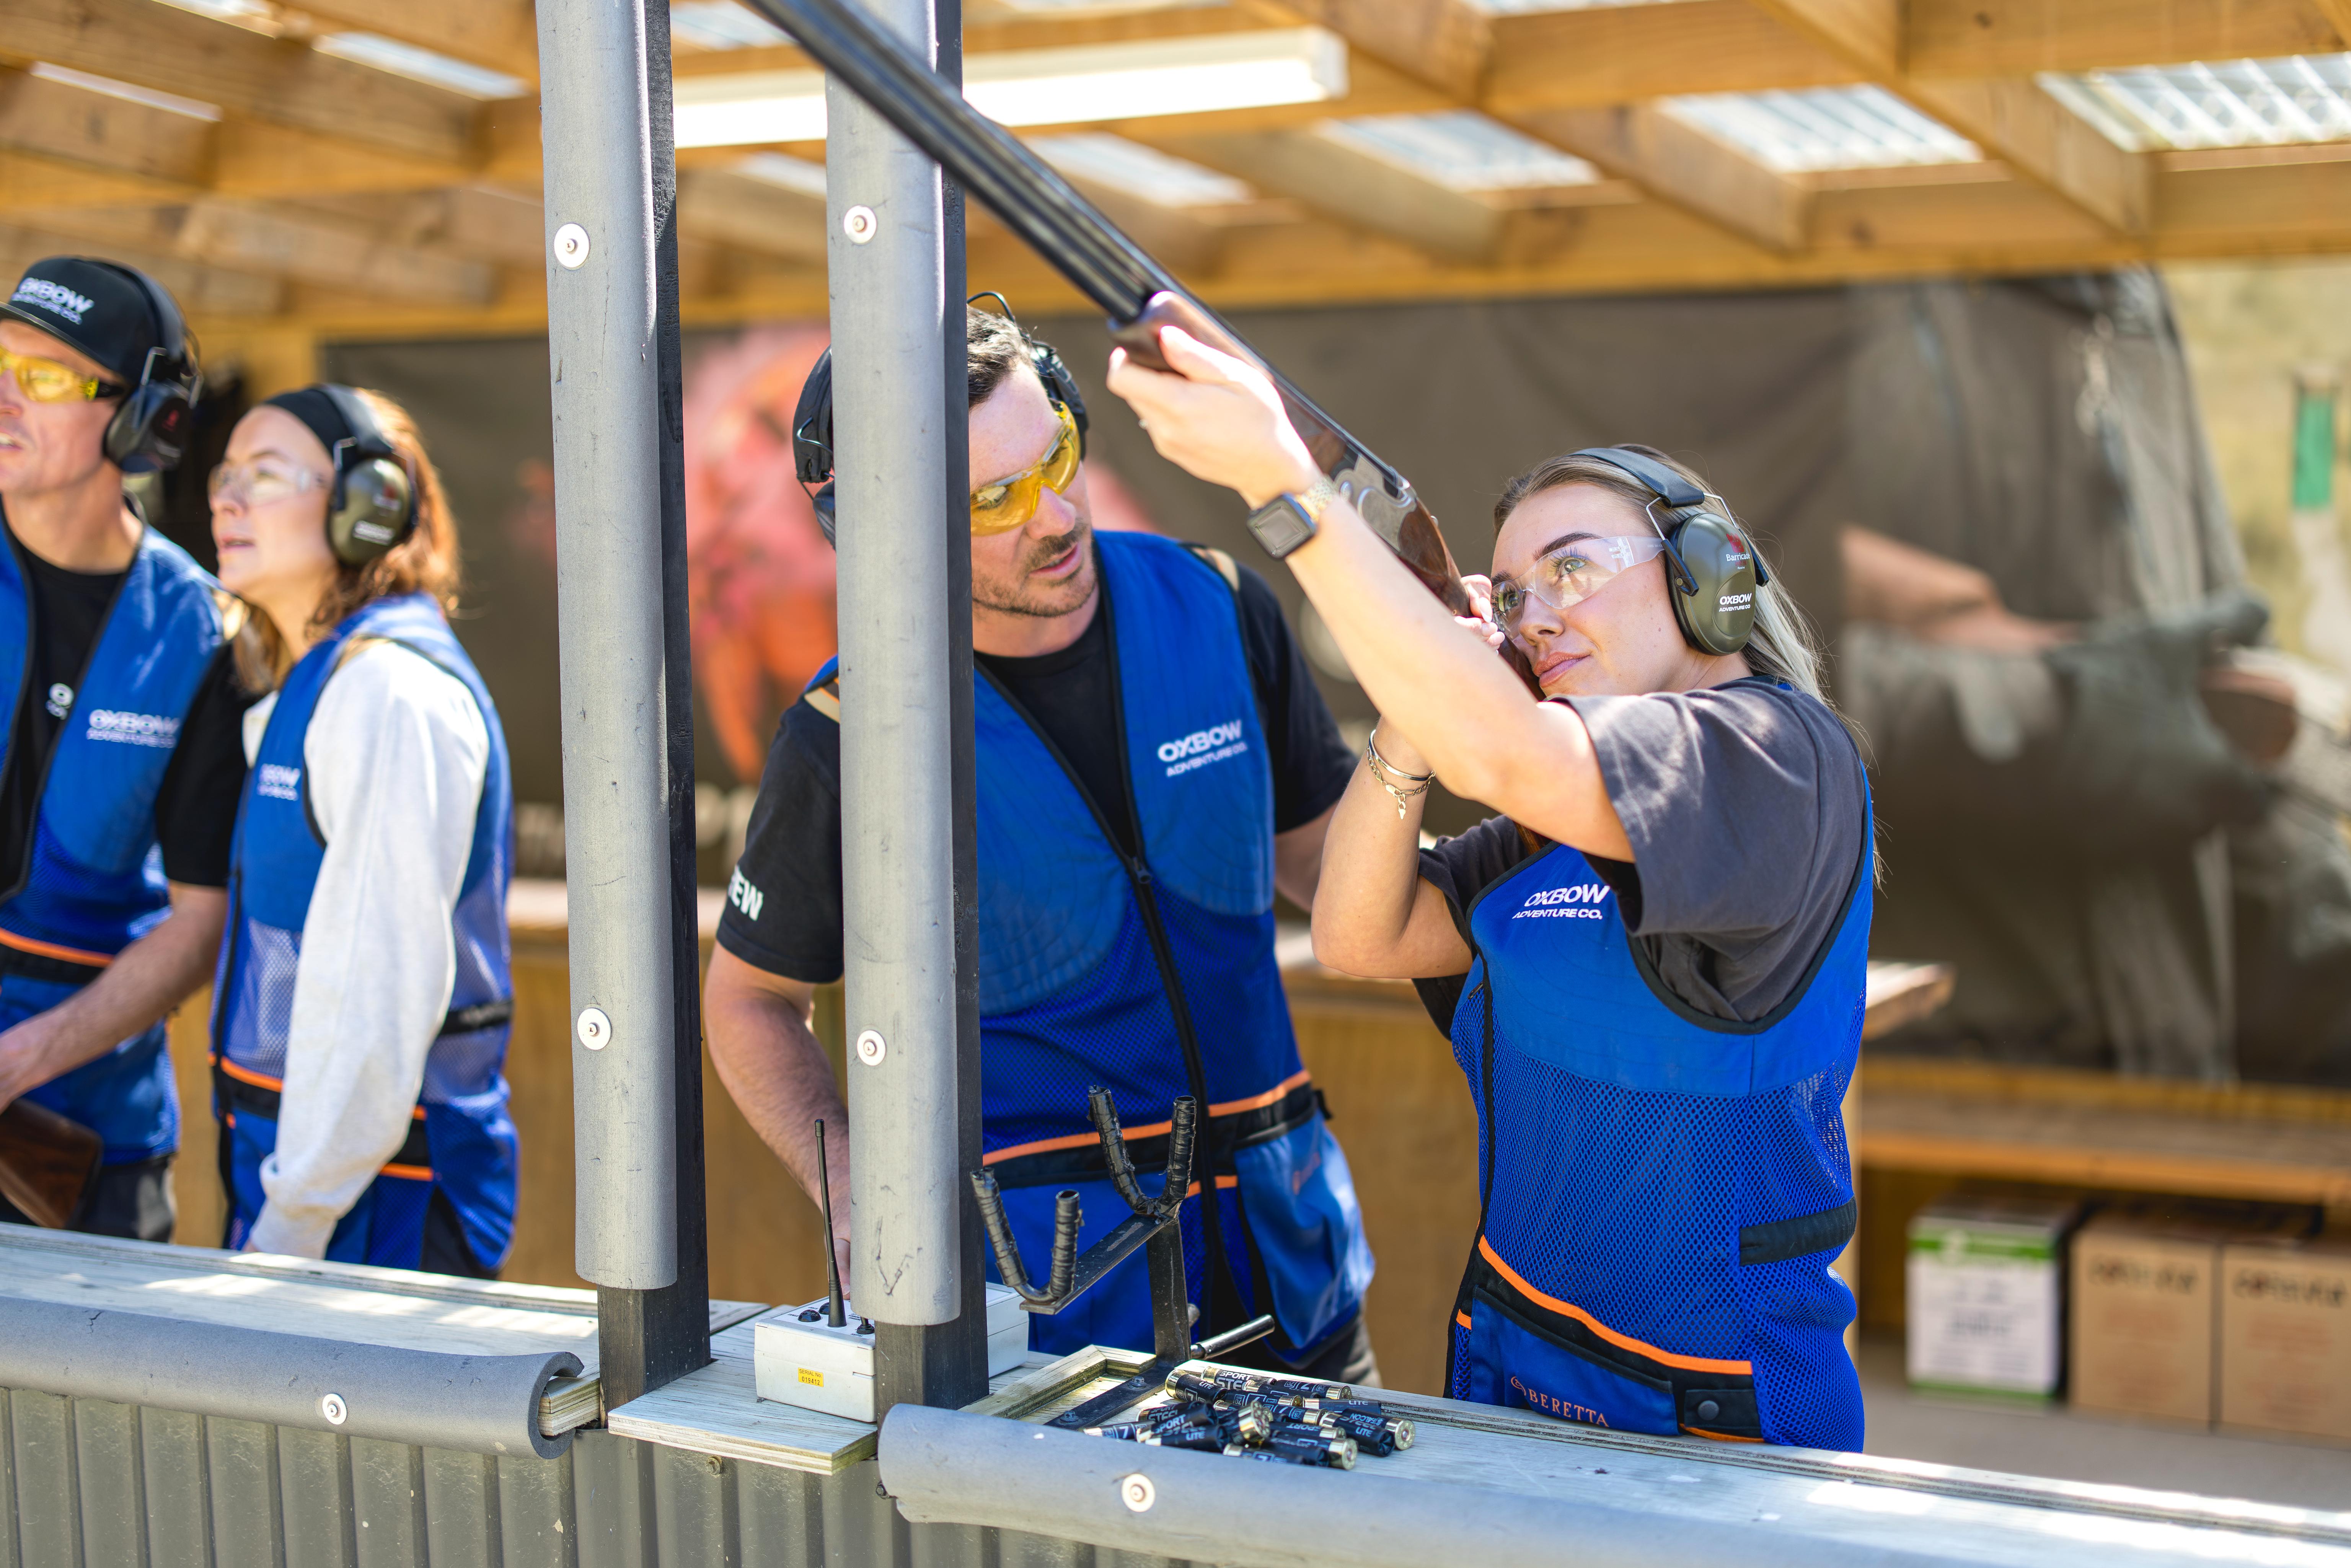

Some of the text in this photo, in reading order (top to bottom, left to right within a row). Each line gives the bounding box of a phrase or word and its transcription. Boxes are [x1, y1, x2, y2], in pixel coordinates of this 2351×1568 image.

[1726, 551, 1750, 561] Barricade
[1719, 593, 1752, 605] OXBOW
[89, 709, 181, 735] OXBOW
[1158, 719, 1242, 762] OXBOW
[1166, 747, 1232, 777] ADVENTURE
[1524, 884, 1610, 907] OXBOW
[1512, 908, 1603, 919] ADVENTURE CO.
[802, 1376, 820, 1385] 019412
[1220, 1371, 1253, 1381] SPORT
[1199, 1381, 1214, 1389] LITE
[1188, 1393, 1193, 1402] 7
[1528, 1388, 1609, 1427] BERETTA
[1154, 1414, 1186, 1434] SPORT
[1350, 1413, 1374, 1424] FALCON
[1119, 1426, 1128, 1439] 7
[1186, 1431, 1205, 1441] LITE
[1356, 1426, 1373, 1438] LITE
